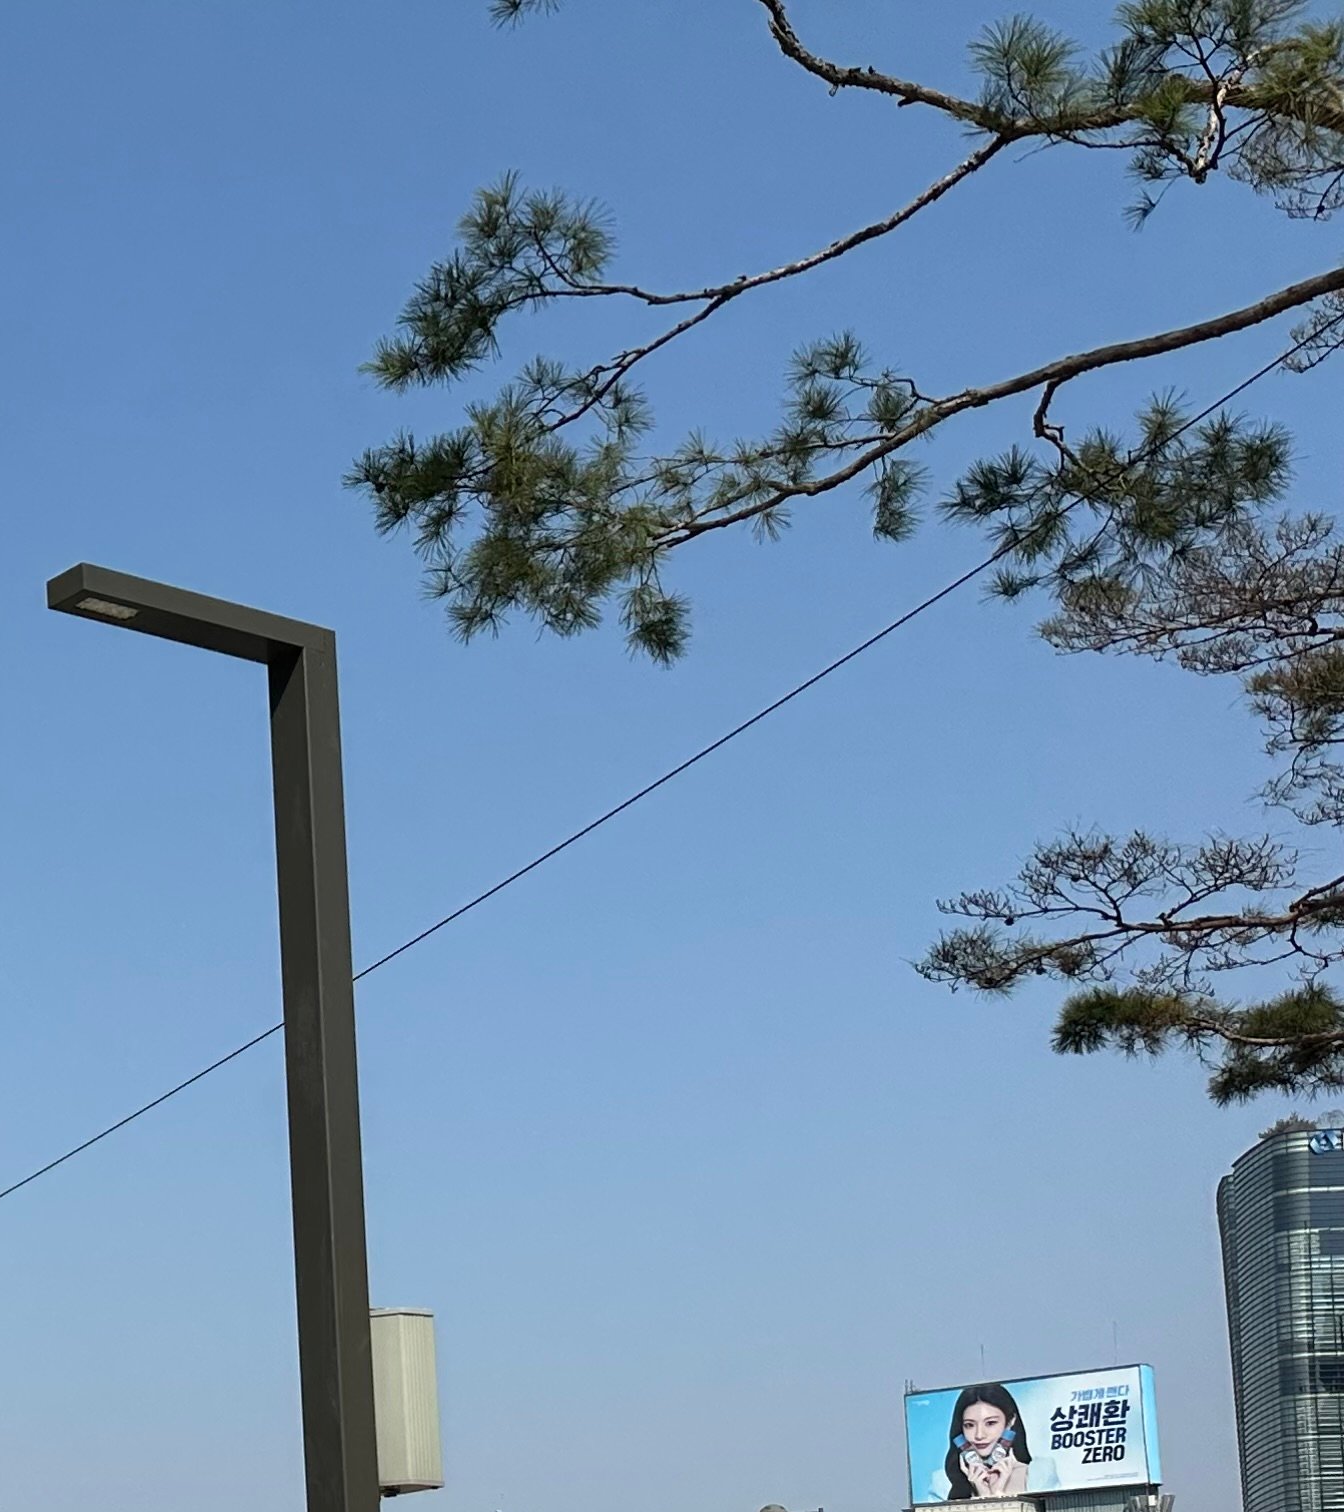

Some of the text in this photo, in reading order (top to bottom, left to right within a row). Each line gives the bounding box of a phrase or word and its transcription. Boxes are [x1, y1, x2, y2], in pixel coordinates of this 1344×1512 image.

[1050, 1399, 1131, 1432] 상쾌환
[1050, 1427, 1127, 1450] BOOSTER
[1081, 1444, 1125, 1464] ZERO
